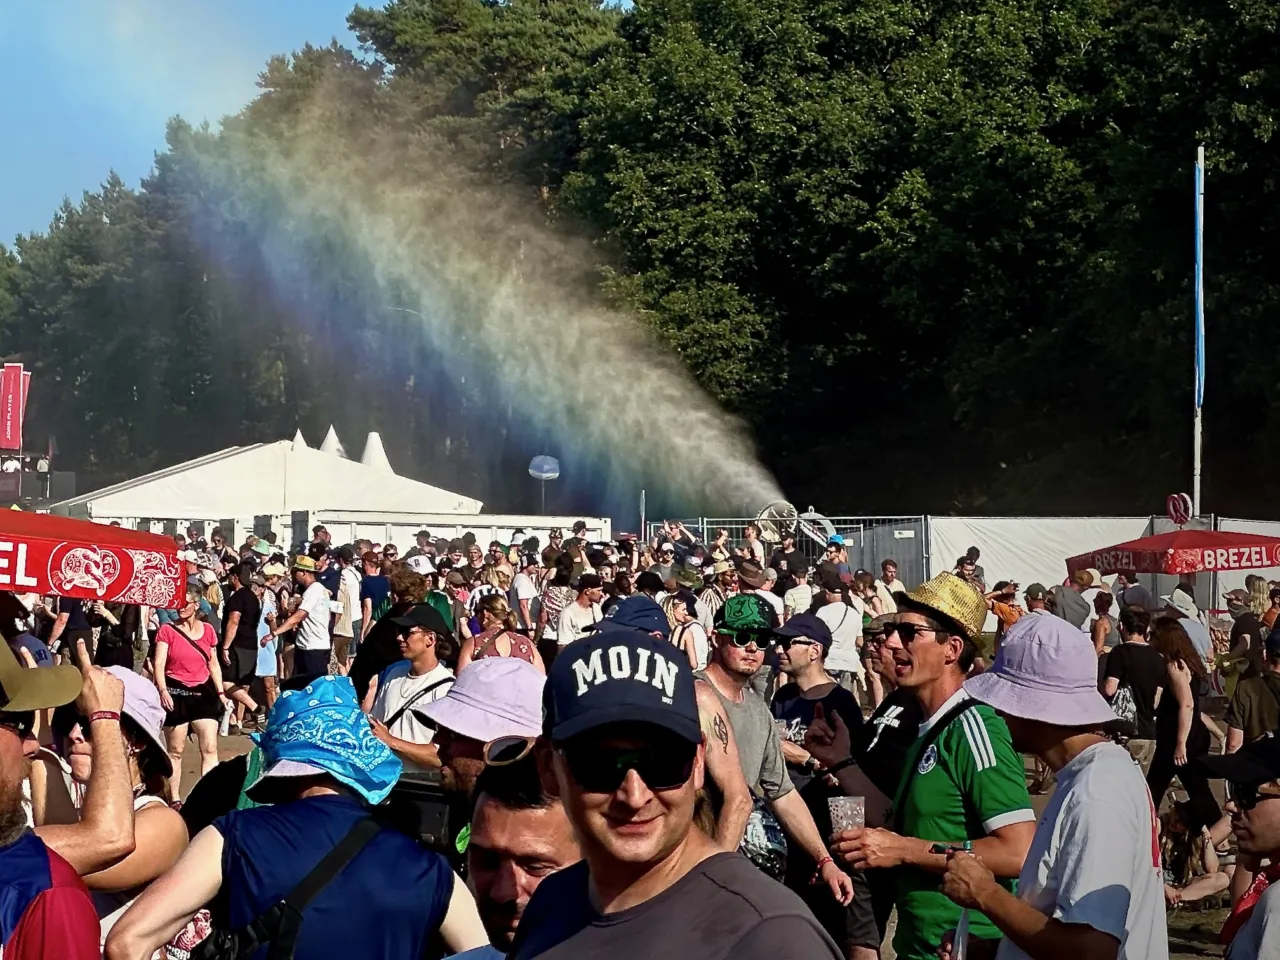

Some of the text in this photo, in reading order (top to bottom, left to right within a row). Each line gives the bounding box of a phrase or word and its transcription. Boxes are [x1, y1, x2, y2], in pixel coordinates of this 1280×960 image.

[1095, 551, 1136, 571] BREZEL
[1204, 546, 1271, 569] BREZEL
[572, 645, 679, 697] MOIN
